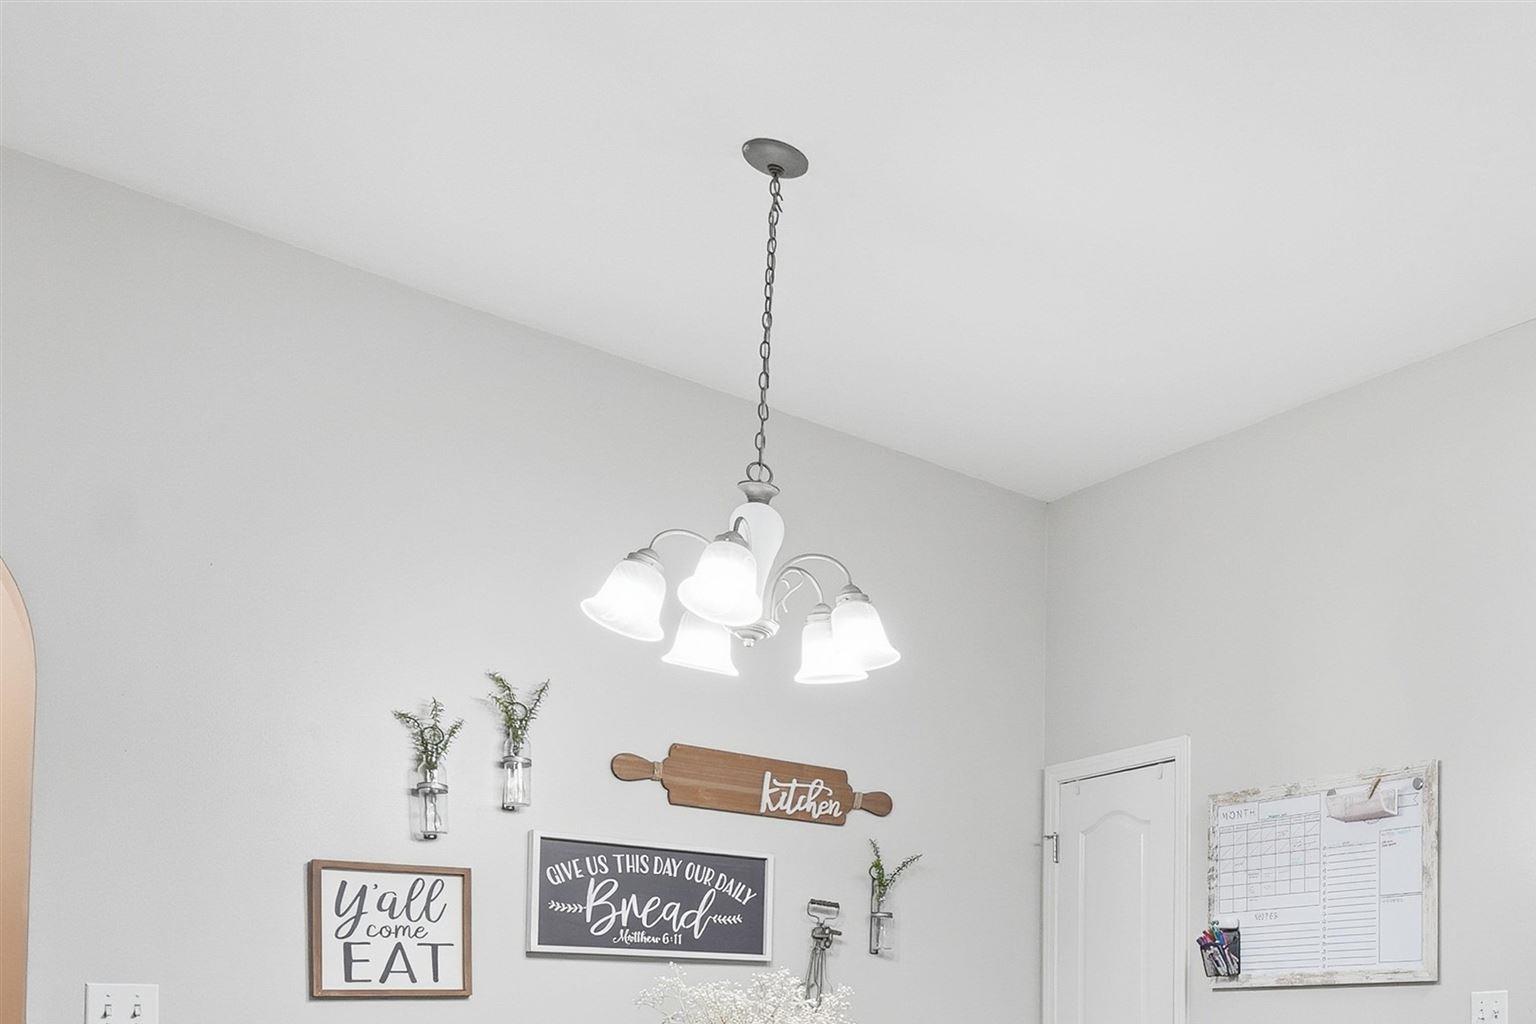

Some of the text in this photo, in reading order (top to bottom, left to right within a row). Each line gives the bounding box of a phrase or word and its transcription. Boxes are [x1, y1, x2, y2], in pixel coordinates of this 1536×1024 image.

[1222, 808, 1256, 821] MONTH
[546, 853, 758, 907] GIVE US THIS DAY OUR DAILY
[585, 876, 717, 940] Bread
[1254, 911, 1280, 922] NOTES
[366, 923, 429, 940] come
[661, 933, 683, 946] 6:11
[342, 941, 455, 985] EAT
